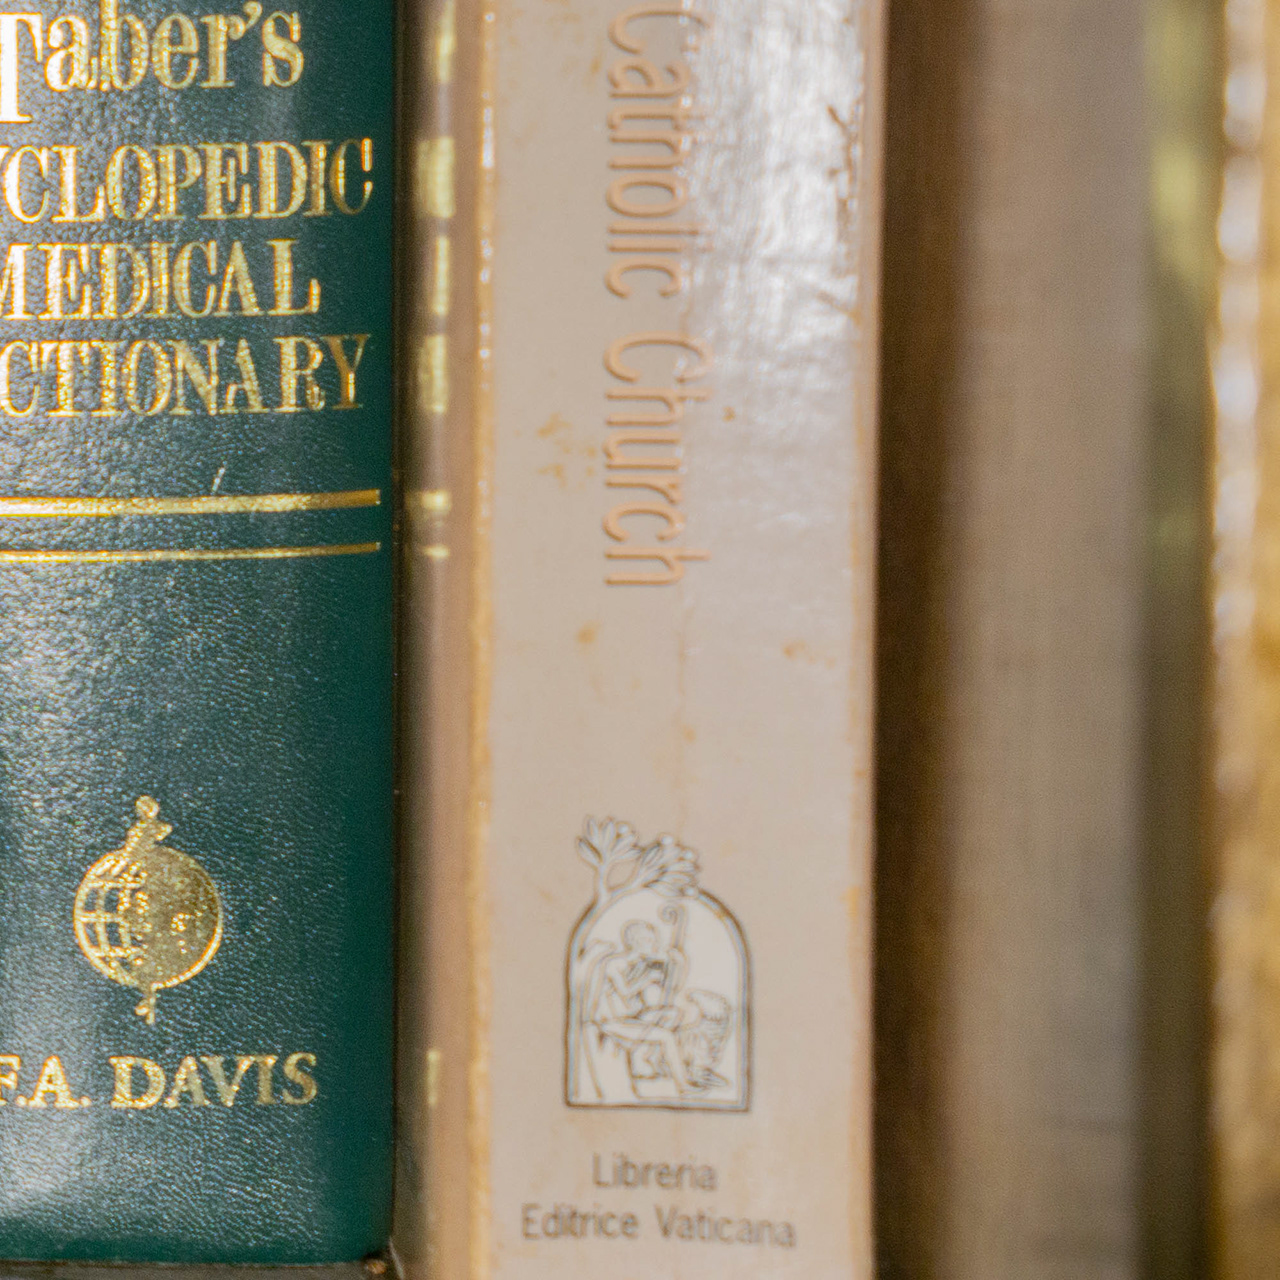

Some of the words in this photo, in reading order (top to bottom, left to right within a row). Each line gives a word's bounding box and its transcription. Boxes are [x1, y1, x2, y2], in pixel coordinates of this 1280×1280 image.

[605, 2, 713, 300] Catholic
[603, 331, 711, 588] Church
[108, 1052, 318, 1110] DAVIS
[592, 1152, 718, 1192] Libreria
[521, 1203, 640, 1240] Editrice
[653, 1203, 797, 1248] Vaticana
